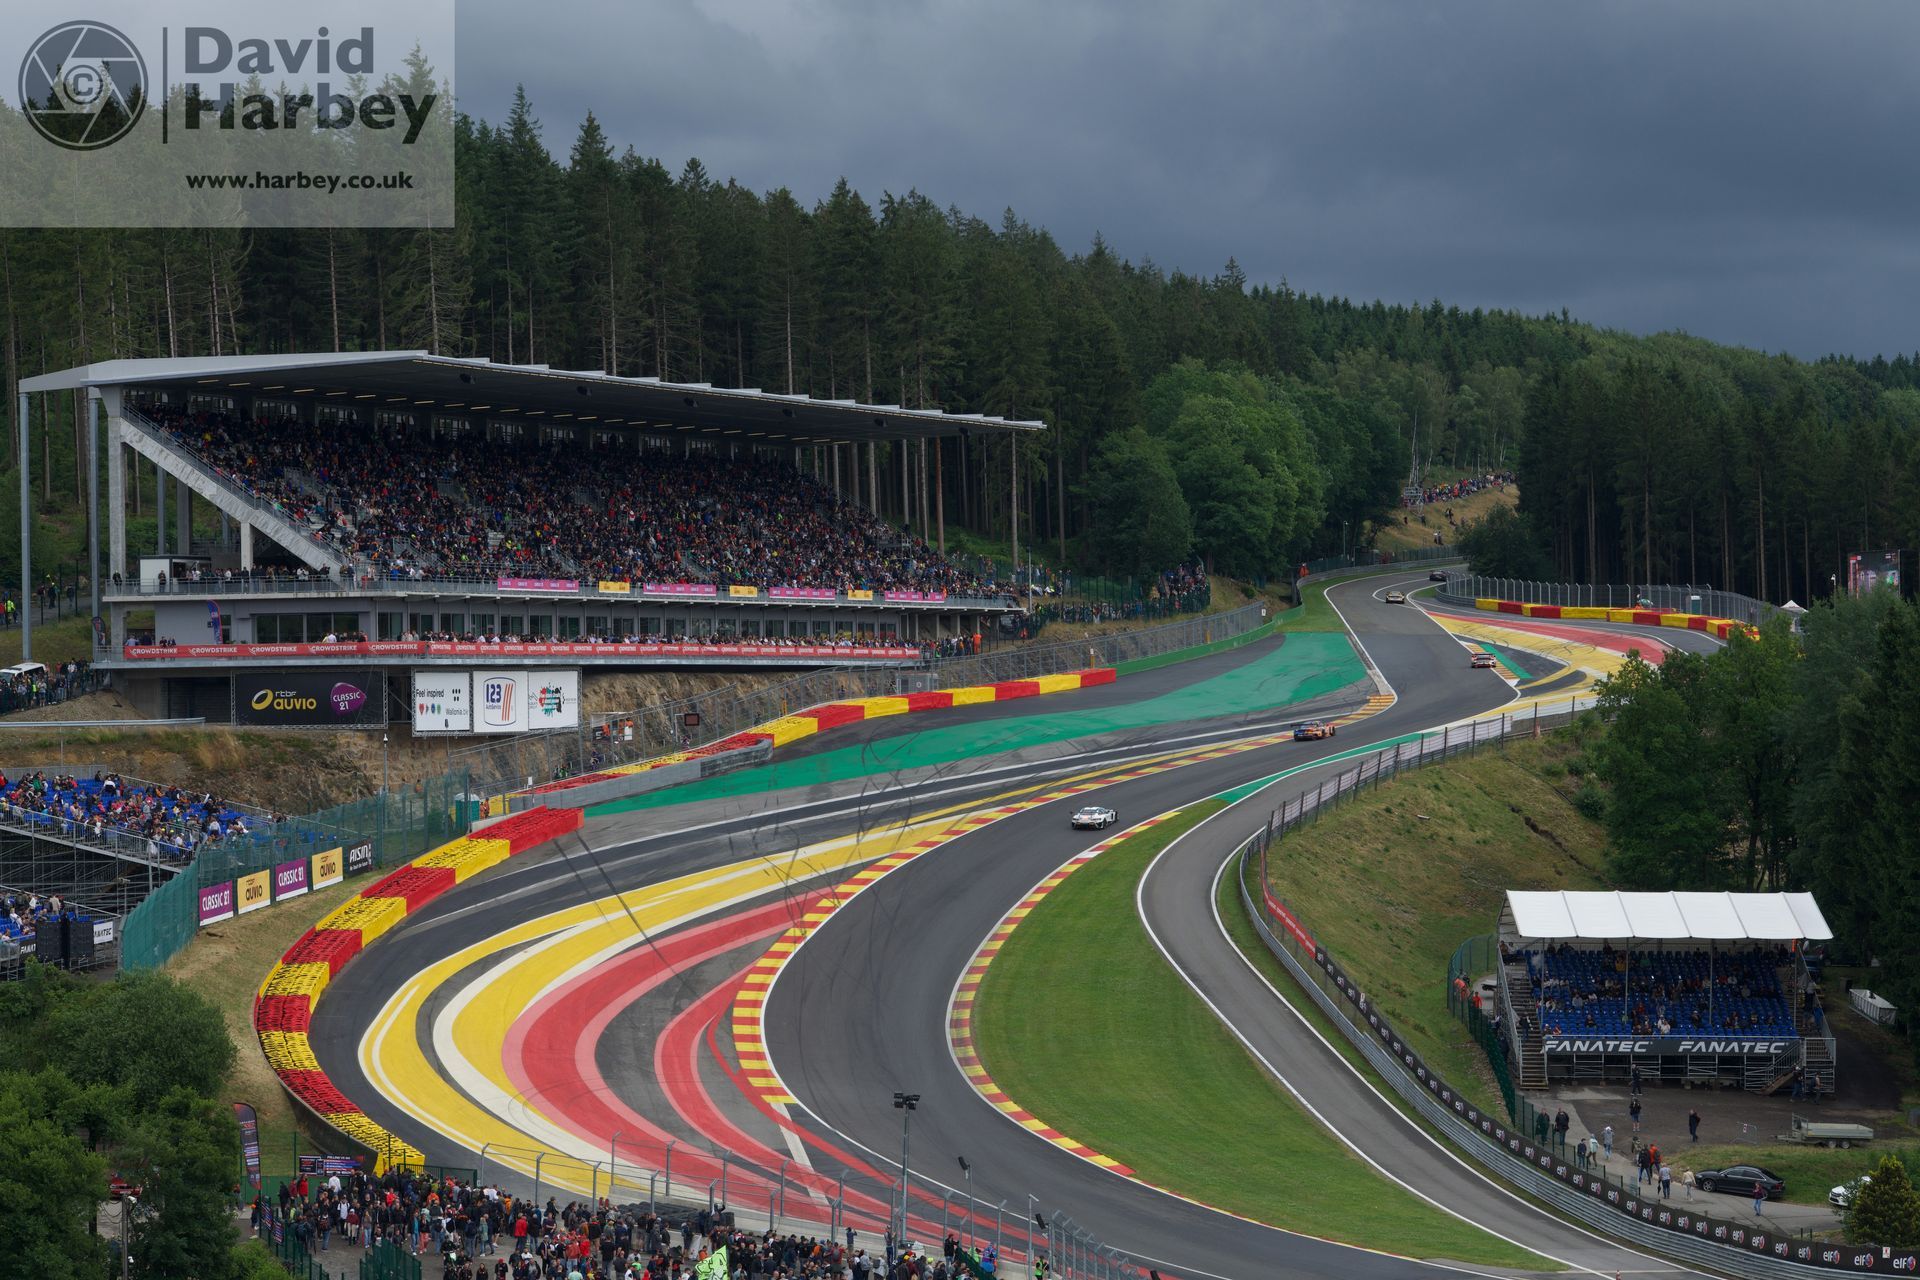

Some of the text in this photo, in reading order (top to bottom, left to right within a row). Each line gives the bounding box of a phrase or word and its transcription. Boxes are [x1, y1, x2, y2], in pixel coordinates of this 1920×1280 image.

[332, 691, 361, 703] CLASSIC
[416, 688, 426, 698] Feel
[486, 683, 502, 704] 123
[273, 698, 318, 711] auvio
[339, 701, 350, 711] 21
[350, 845, 368, 863] AISIN
[278, 868, 298, 887] CLASSIC
[202, 892, 223, 912] CLASSIC
[1541, 1040, 1786, 1054] FANATEC FANATEC
[1822, 1251, 1833, 1262] elf
[1854, 1255, 1866, 1266] elf
[1893, 1257, 1907, 1269] elf
